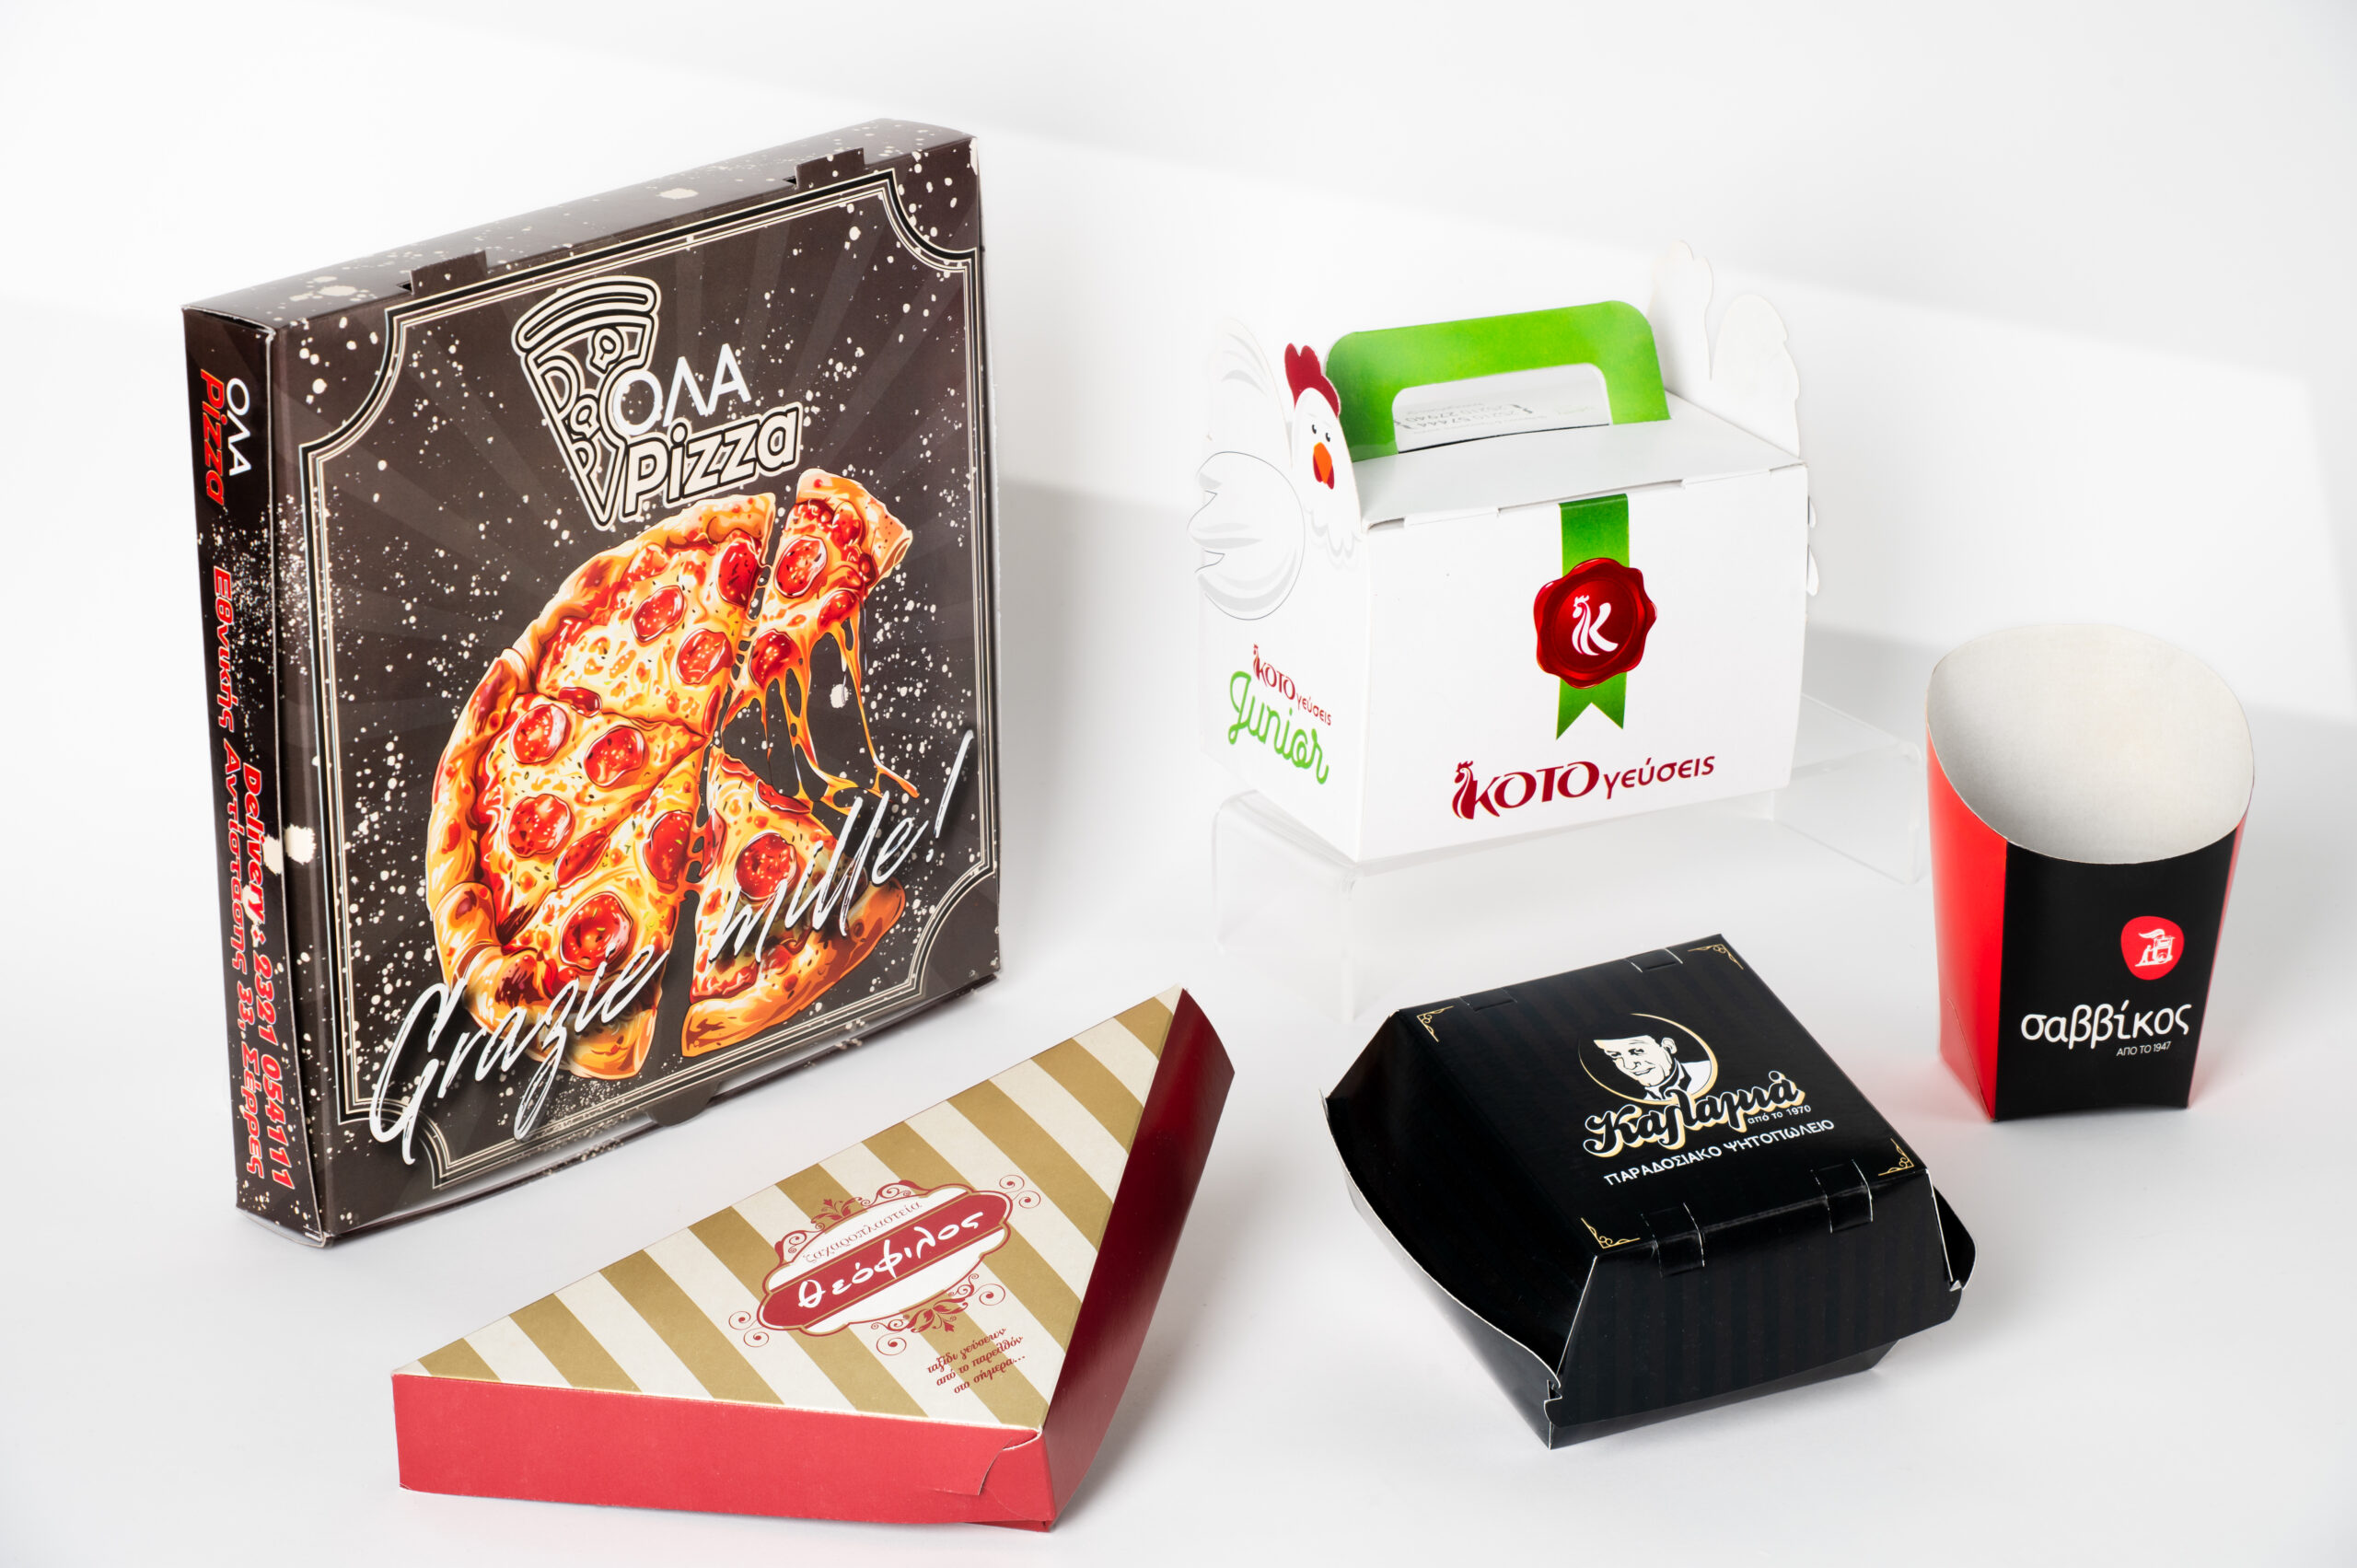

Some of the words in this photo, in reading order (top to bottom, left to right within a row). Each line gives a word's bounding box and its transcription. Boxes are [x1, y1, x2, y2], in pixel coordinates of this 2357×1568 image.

[200, 368, 225, 505] Pizza
[226, 377, 252, 476] ΟΛΑ
[613, 343, 752, 436] ΟΛΑ
[621, 401, 804, 518] Pizza
[1228, 670, 1329, 784] Junior
[213, 565, 239, 732] Εθνικής
[241, 1040, 265, 1179] Σέρρες
[251, 949, 279, 1047] 2321
[369, 935, 671, 1164] Grazie
[2021, 999, 2192, 1050] σαββίκος
[261, 1052, 296, 1191] 054111
[1786, 1105, 1812, 1116] 1970
[1604, 1145, 1722, 1186] ΠΑΡΑΔΟΣΙΑΚΟ
